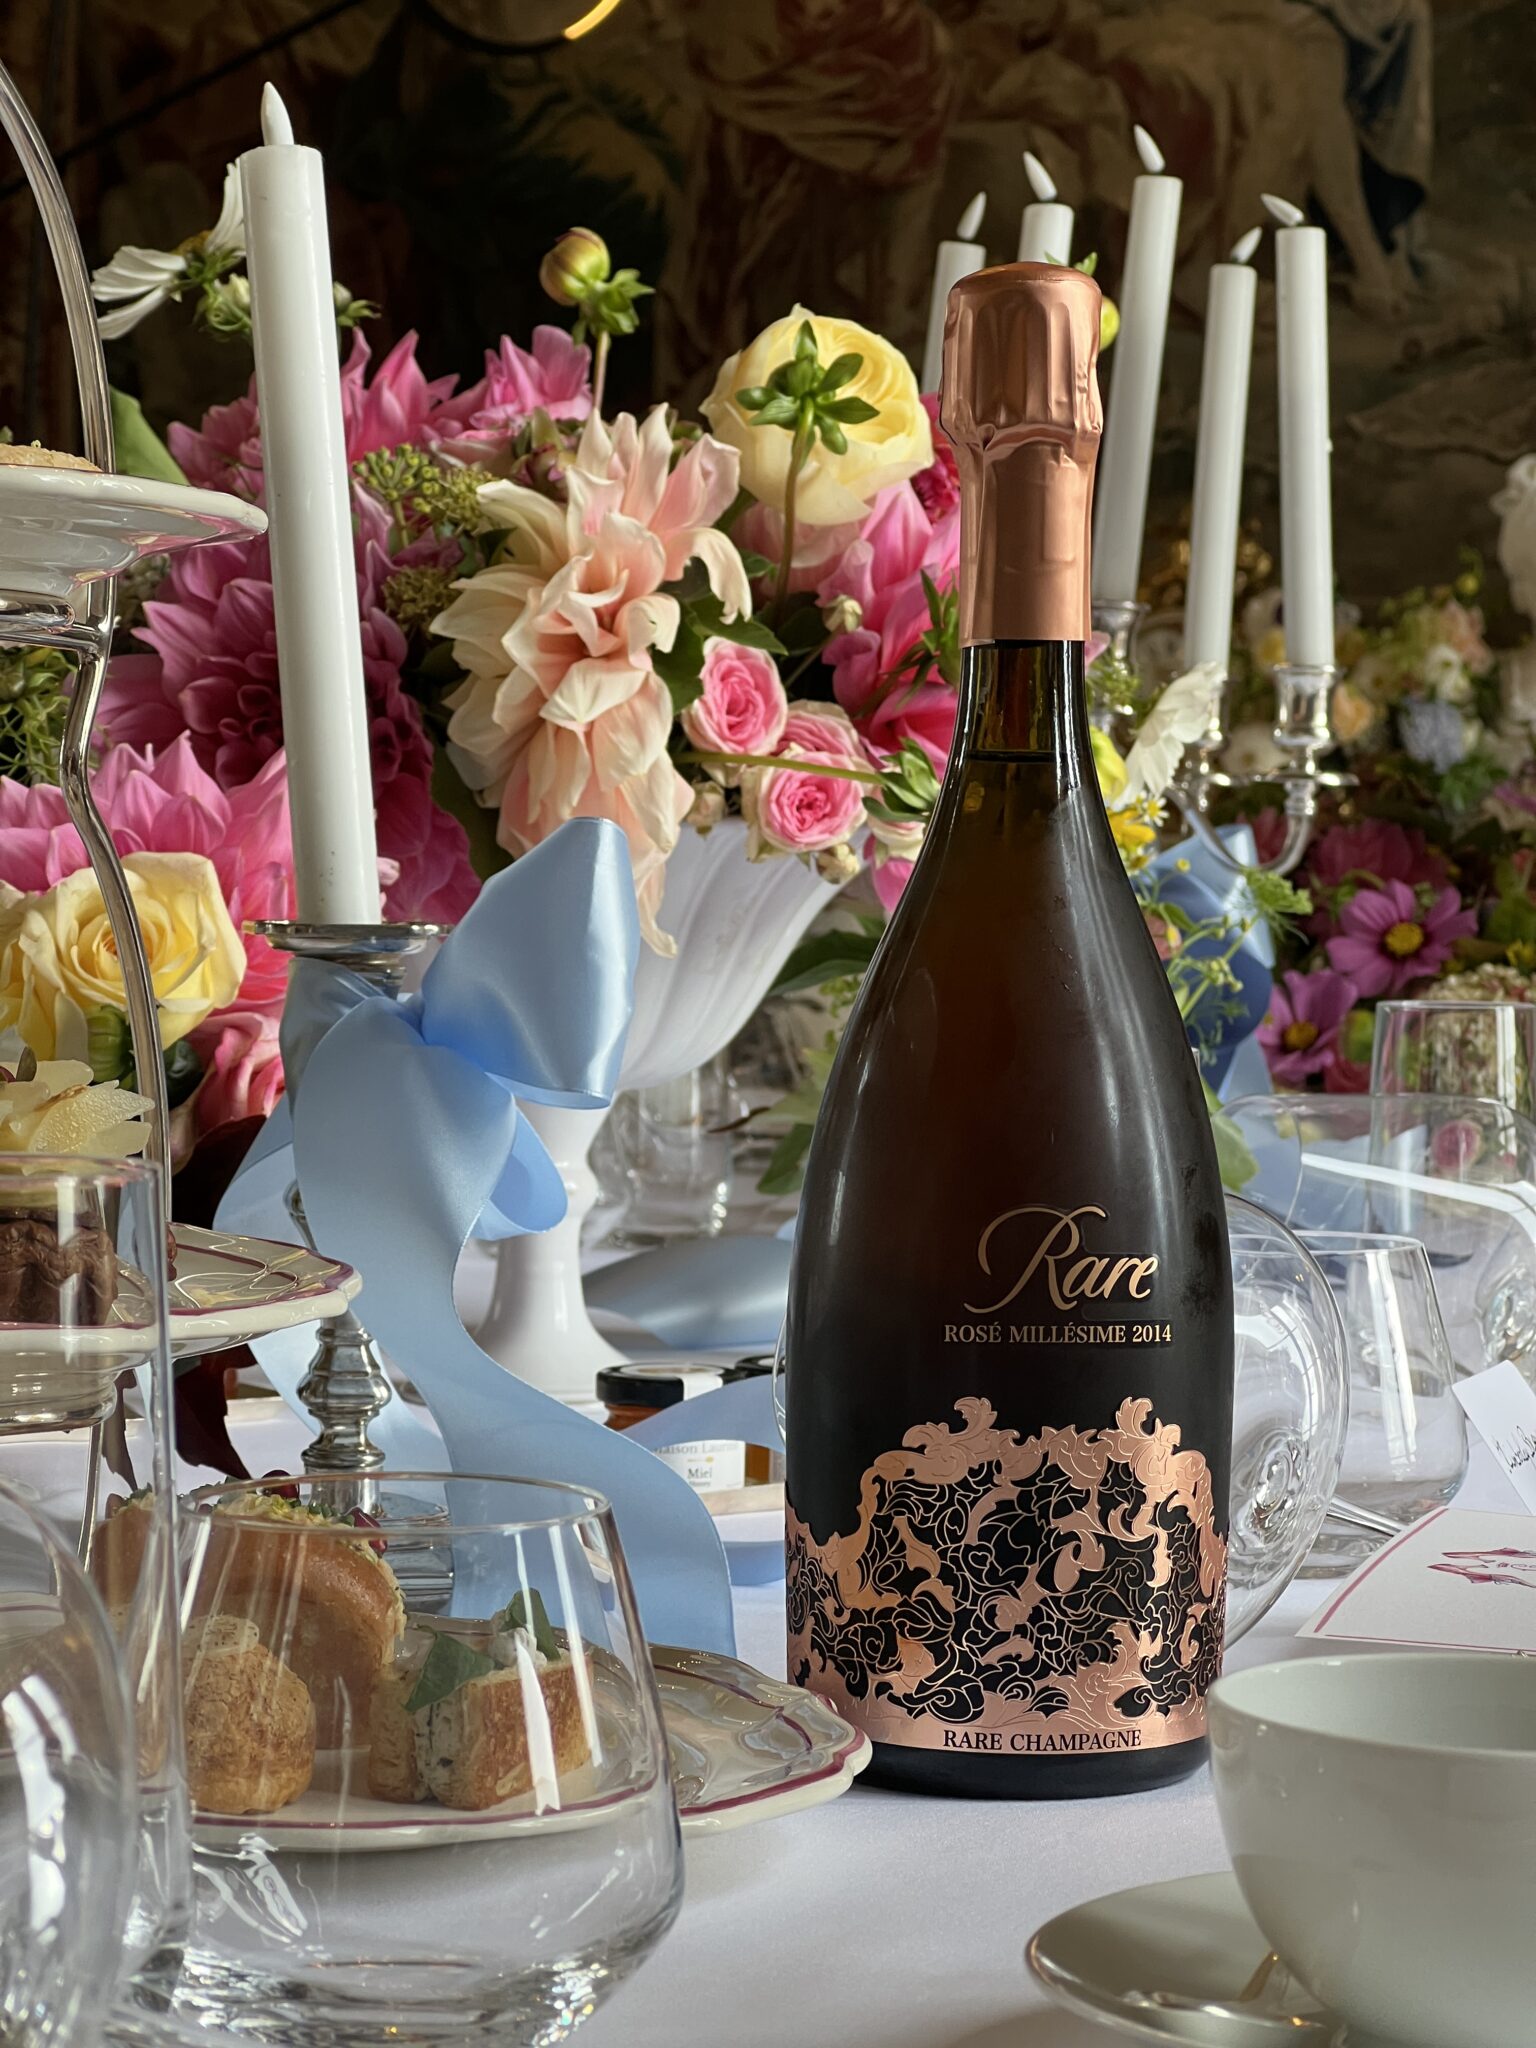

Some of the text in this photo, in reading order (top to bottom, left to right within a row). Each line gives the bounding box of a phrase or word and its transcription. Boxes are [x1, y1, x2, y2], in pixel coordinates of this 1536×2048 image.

[963, 1205, 1159, 1314] Rare
[943, 1322, 1172, 1343] ROSÉ MILLÉSIME 2014
[943, 1729, 1142, 1751] RARE CHAMPAGNE
